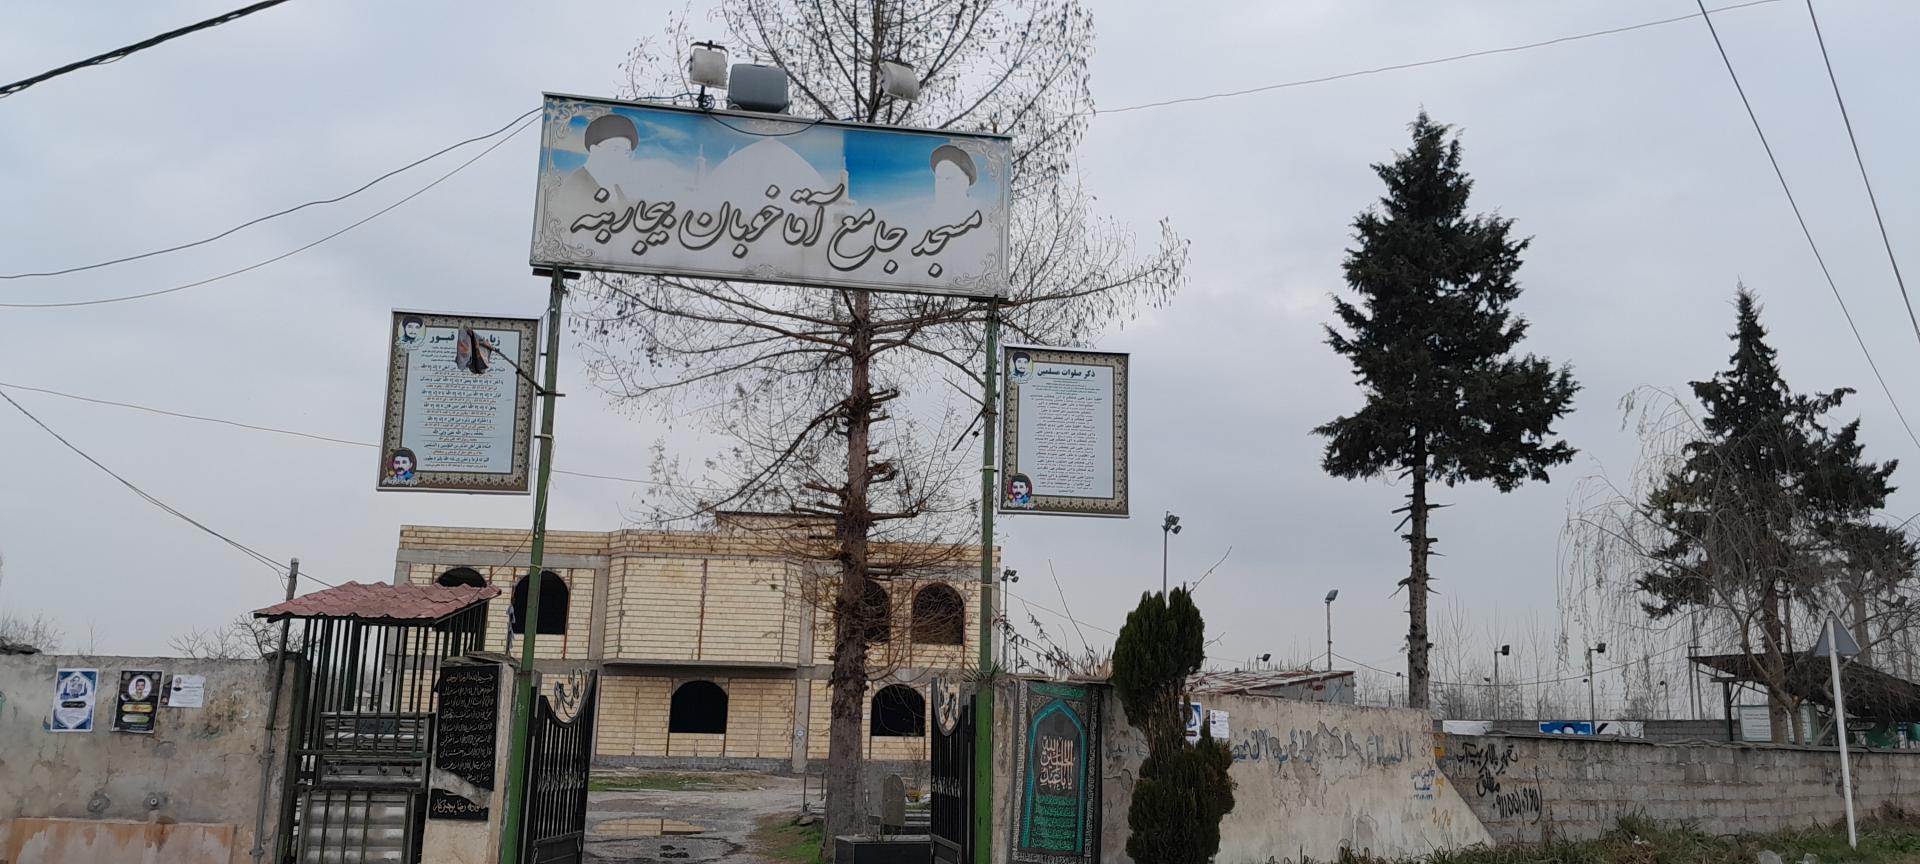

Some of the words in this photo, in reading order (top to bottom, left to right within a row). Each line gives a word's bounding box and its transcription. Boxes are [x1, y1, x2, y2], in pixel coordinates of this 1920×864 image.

[827, 208, 908, 275] جامع
[911, 208, 983, 278] مسجد
[1061, 368, 1082, 379] صلوات
